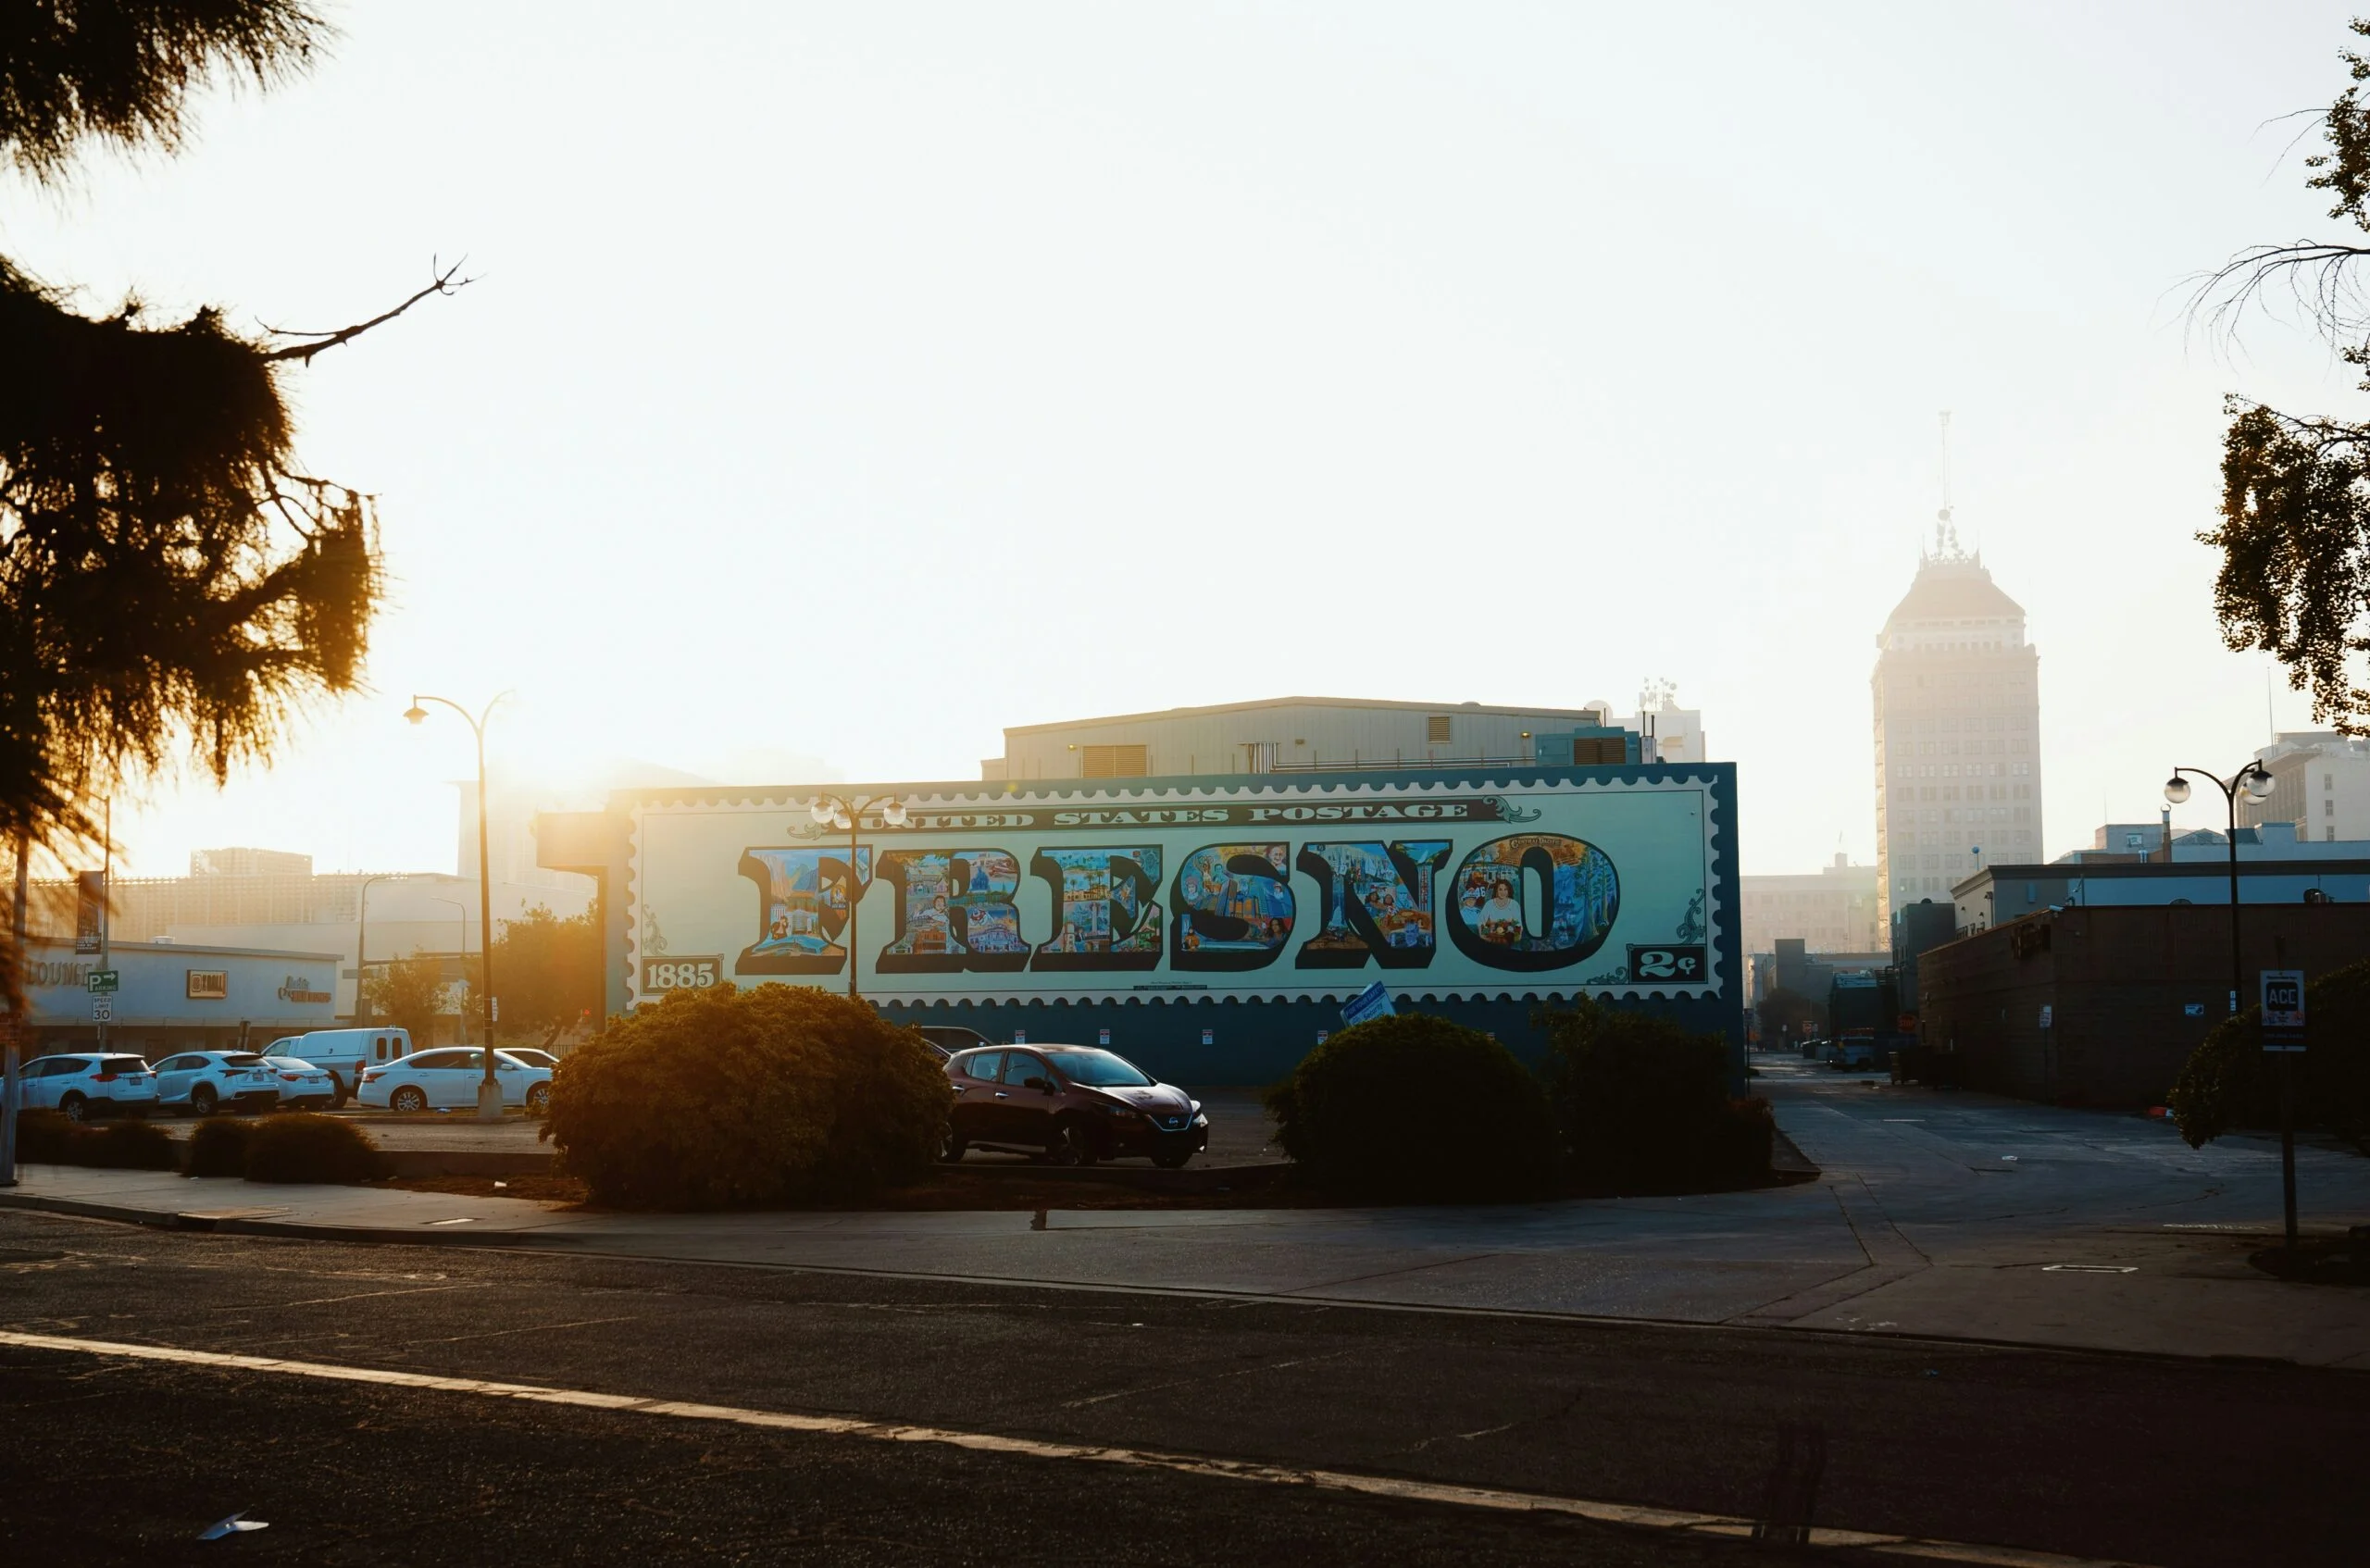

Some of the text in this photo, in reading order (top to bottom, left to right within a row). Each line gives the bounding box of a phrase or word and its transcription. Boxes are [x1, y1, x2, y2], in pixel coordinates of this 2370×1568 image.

[1054, 807, 1229, 826] STATES
[1248, 803, 1468, 822] POSTAGE
[734, 832, 1620, 976] FRESNO
[647, 963, 715, 989] 1885
[2268, 988, 2297, 1005] ACE
[94, 1009, 110, 1020] 30
